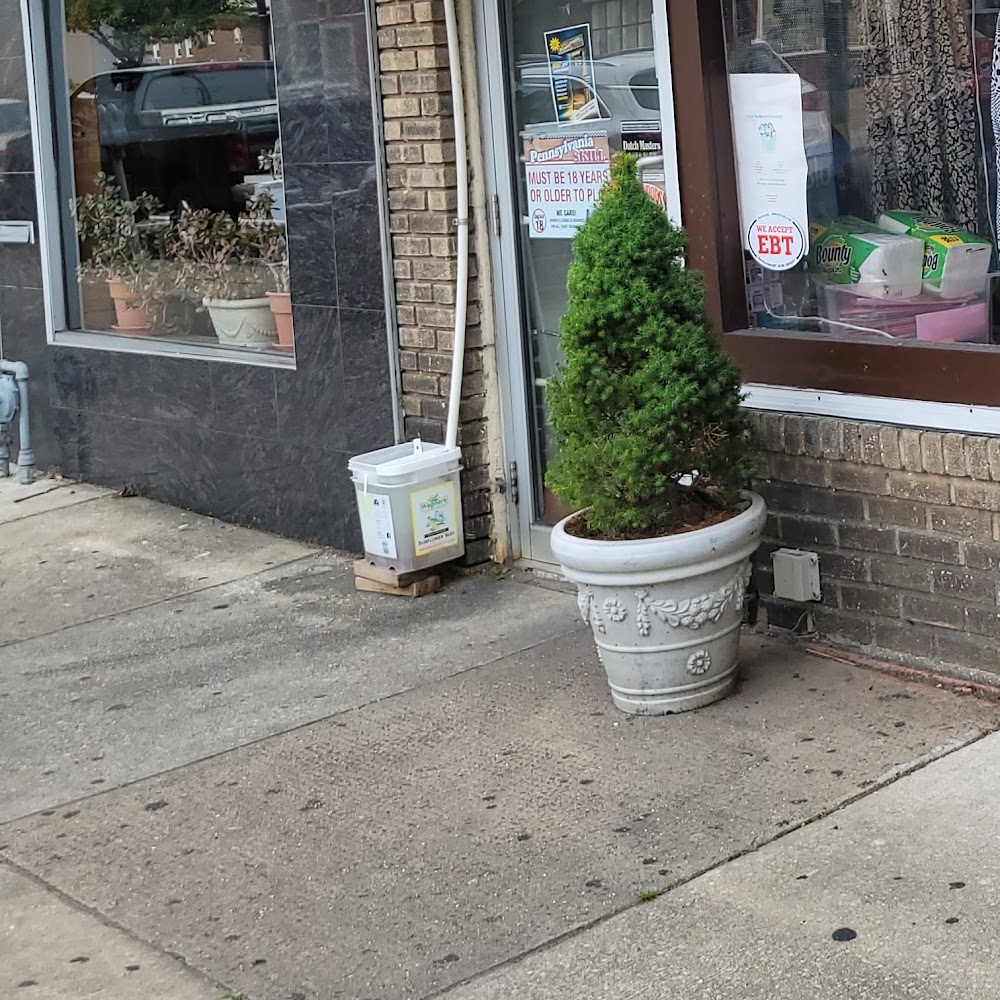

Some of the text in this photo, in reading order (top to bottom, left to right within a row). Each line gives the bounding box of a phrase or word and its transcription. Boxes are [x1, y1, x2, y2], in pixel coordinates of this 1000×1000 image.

[530, 134, 594, 162] Pennsylvania
[623, 140, 639, 151] Dutch
[573, 149, 606, 162] SKILL
[528, 169, 608, 184] MUST BE 18 YEARS
[530, 189, 541, 202] OR
[544, 189, 571, 202] OLDER
[574, 188, 585, 202] TO
[756, 225, 793, 234] WE ACCEPT
[757, 235, 794, 256] EBT
[816, 244, 852, 266] Bounty
